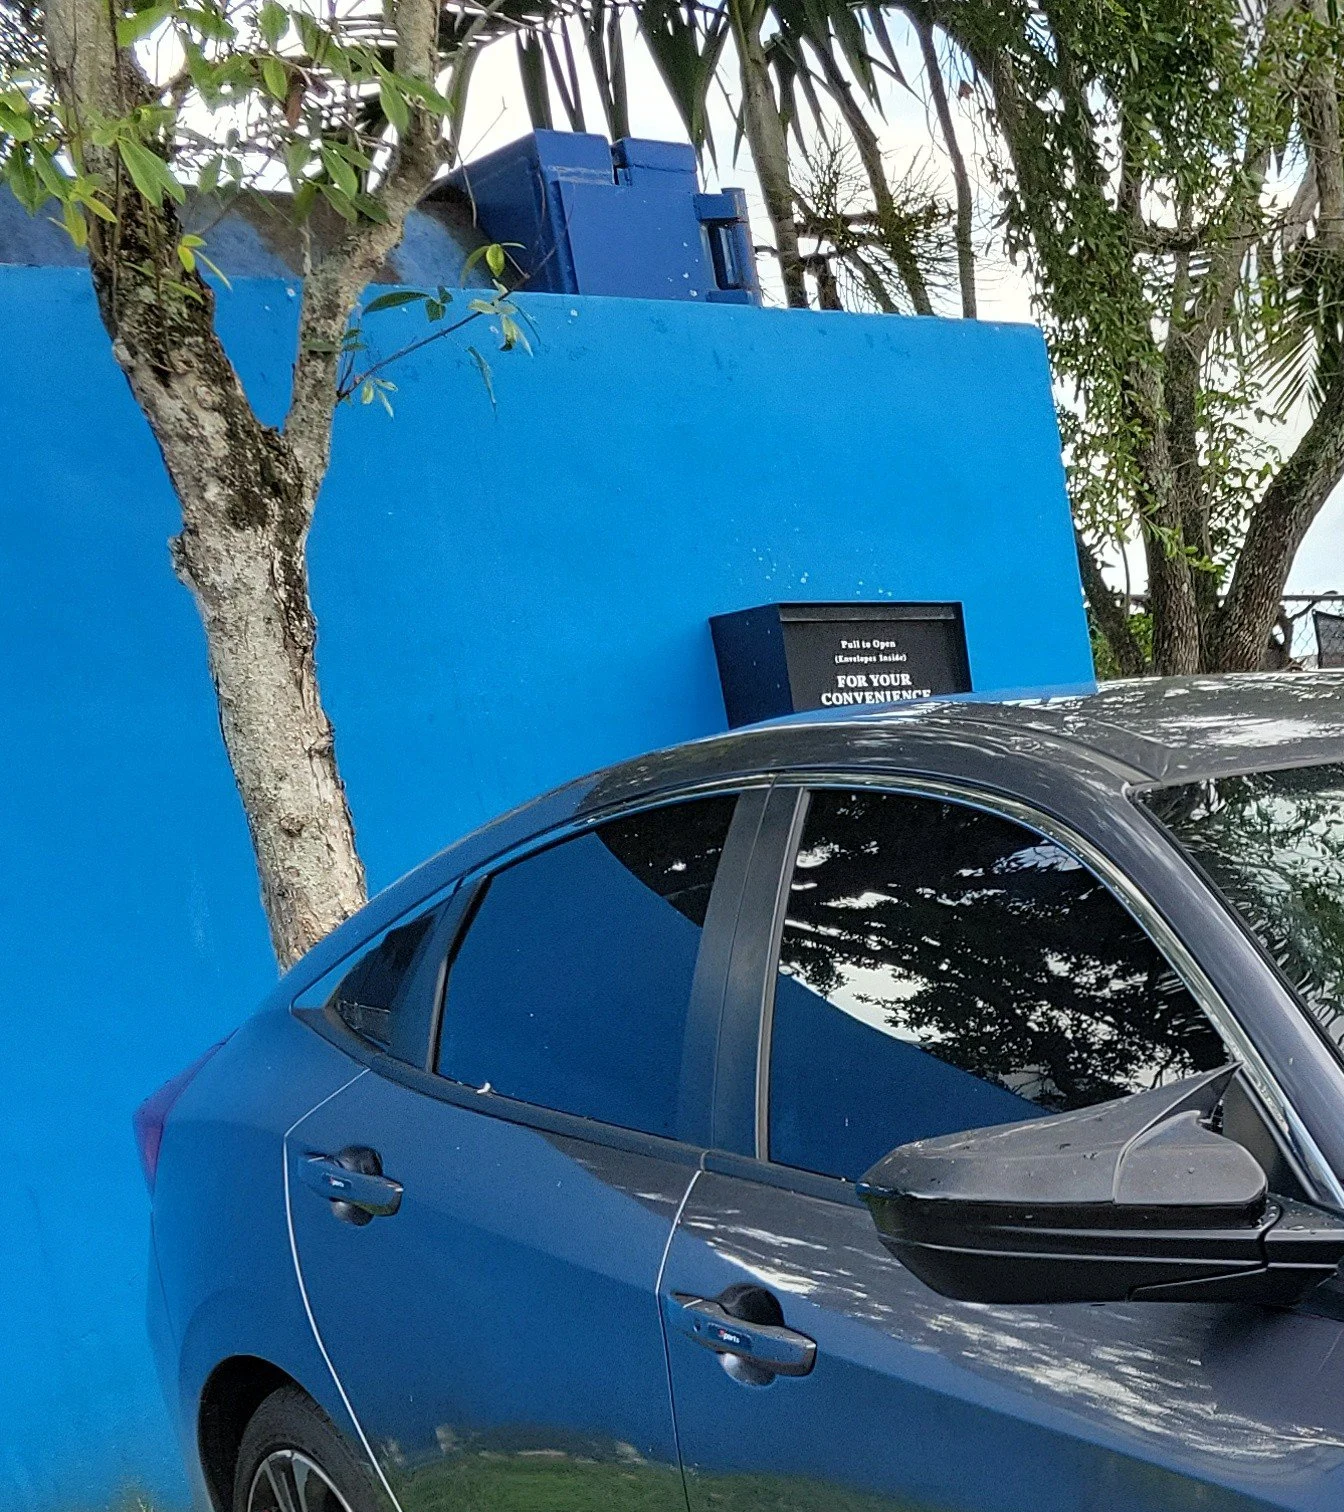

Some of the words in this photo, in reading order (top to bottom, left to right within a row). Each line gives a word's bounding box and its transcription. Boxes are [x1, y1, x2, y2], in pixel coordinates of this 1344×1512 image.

[841, 640, 860, 649] Pull
[862, 641, 871, 649] to
[872, 640, 896, 650] Open
[837, 675, 868, 688] FOR
[869, 674, 912, 687] YOUR
[821, 690, 931, 706] CONVENIENCE
